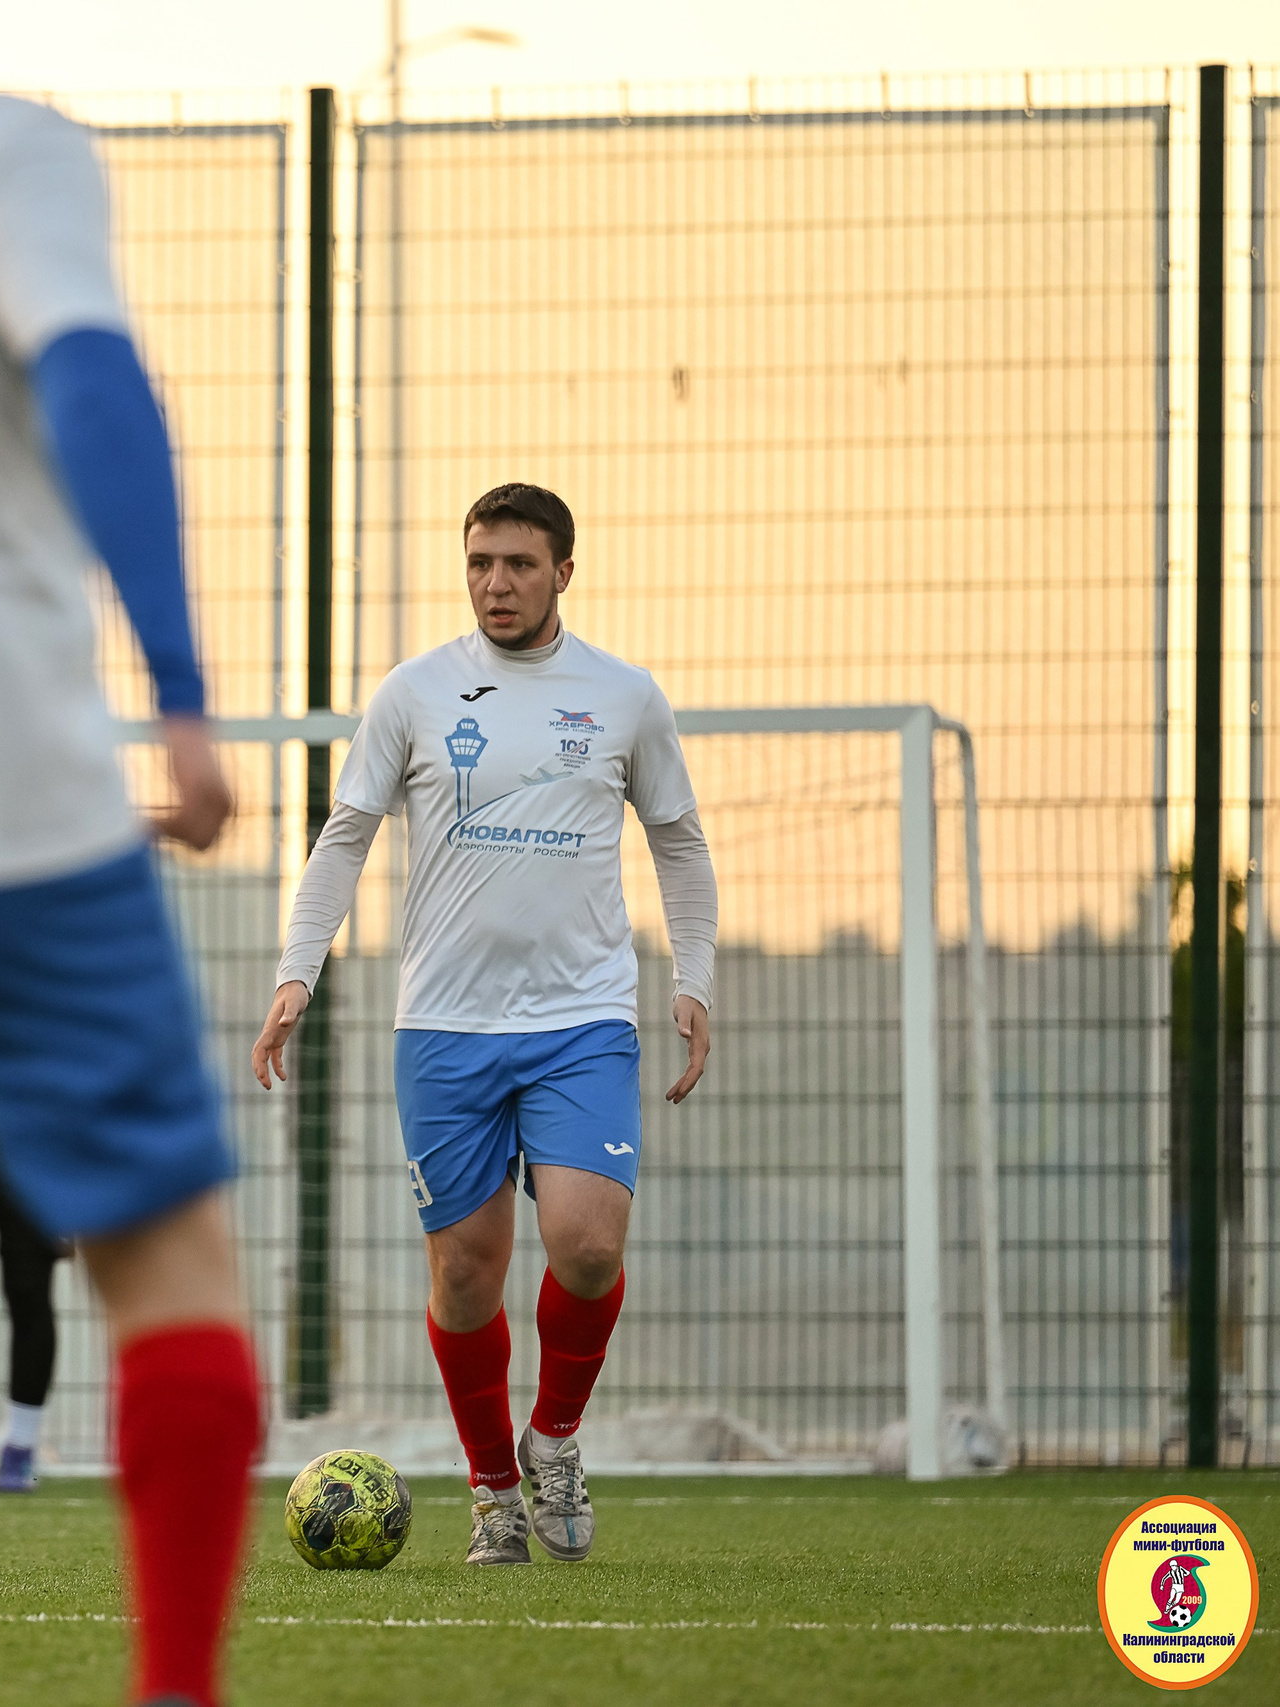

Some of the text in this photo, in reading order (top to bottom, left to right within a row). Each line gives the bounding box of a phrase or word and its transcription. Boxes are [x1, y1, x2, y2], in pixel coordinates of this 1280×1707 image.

[549, 721, 605, 732] ХРАБРОВО
[560, 739, 589, 755] 100
[458, 825, 586, 848] НОВАПОРТ
[456, 843, 580, 859] АЭРОПОРТЫ РОССИИ
[329, 1456, 390, 1502] SELECT
